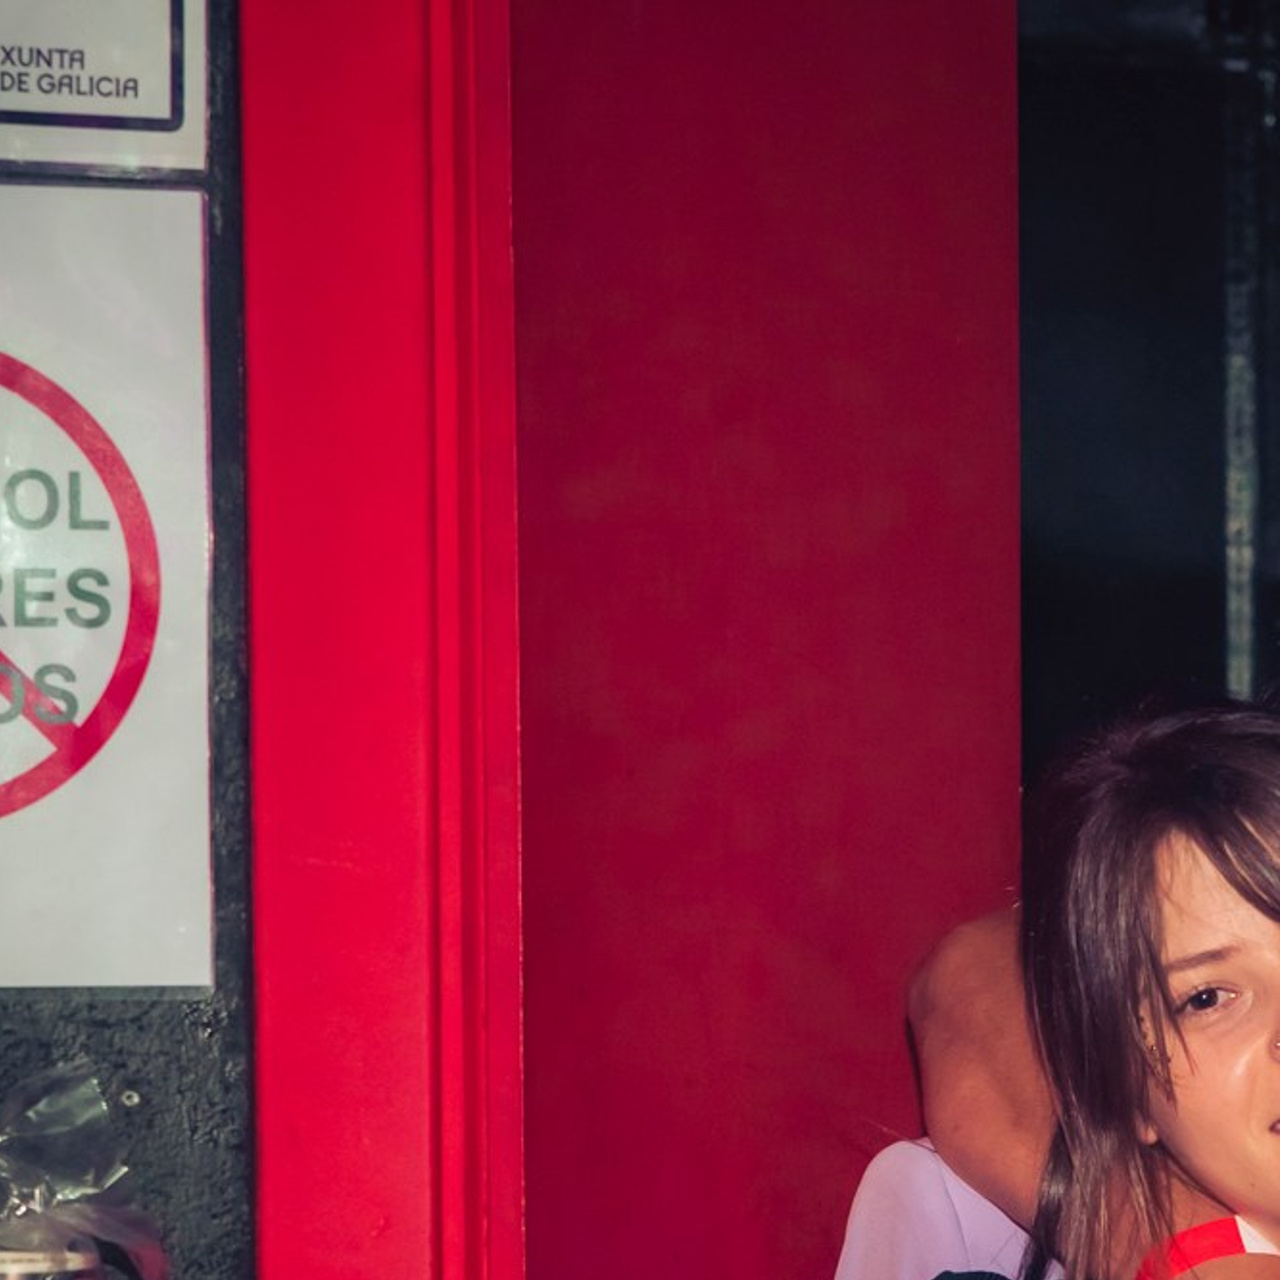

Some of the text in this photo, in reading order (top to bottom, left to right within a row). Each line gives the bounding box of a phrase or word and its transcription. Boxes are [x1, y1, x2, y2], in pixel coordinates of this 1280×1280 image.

[0, 46, 85, 71] XUNTA
[0, 72, 140, 98] DE GALICIA
[0, 567, 112, 629] ES
